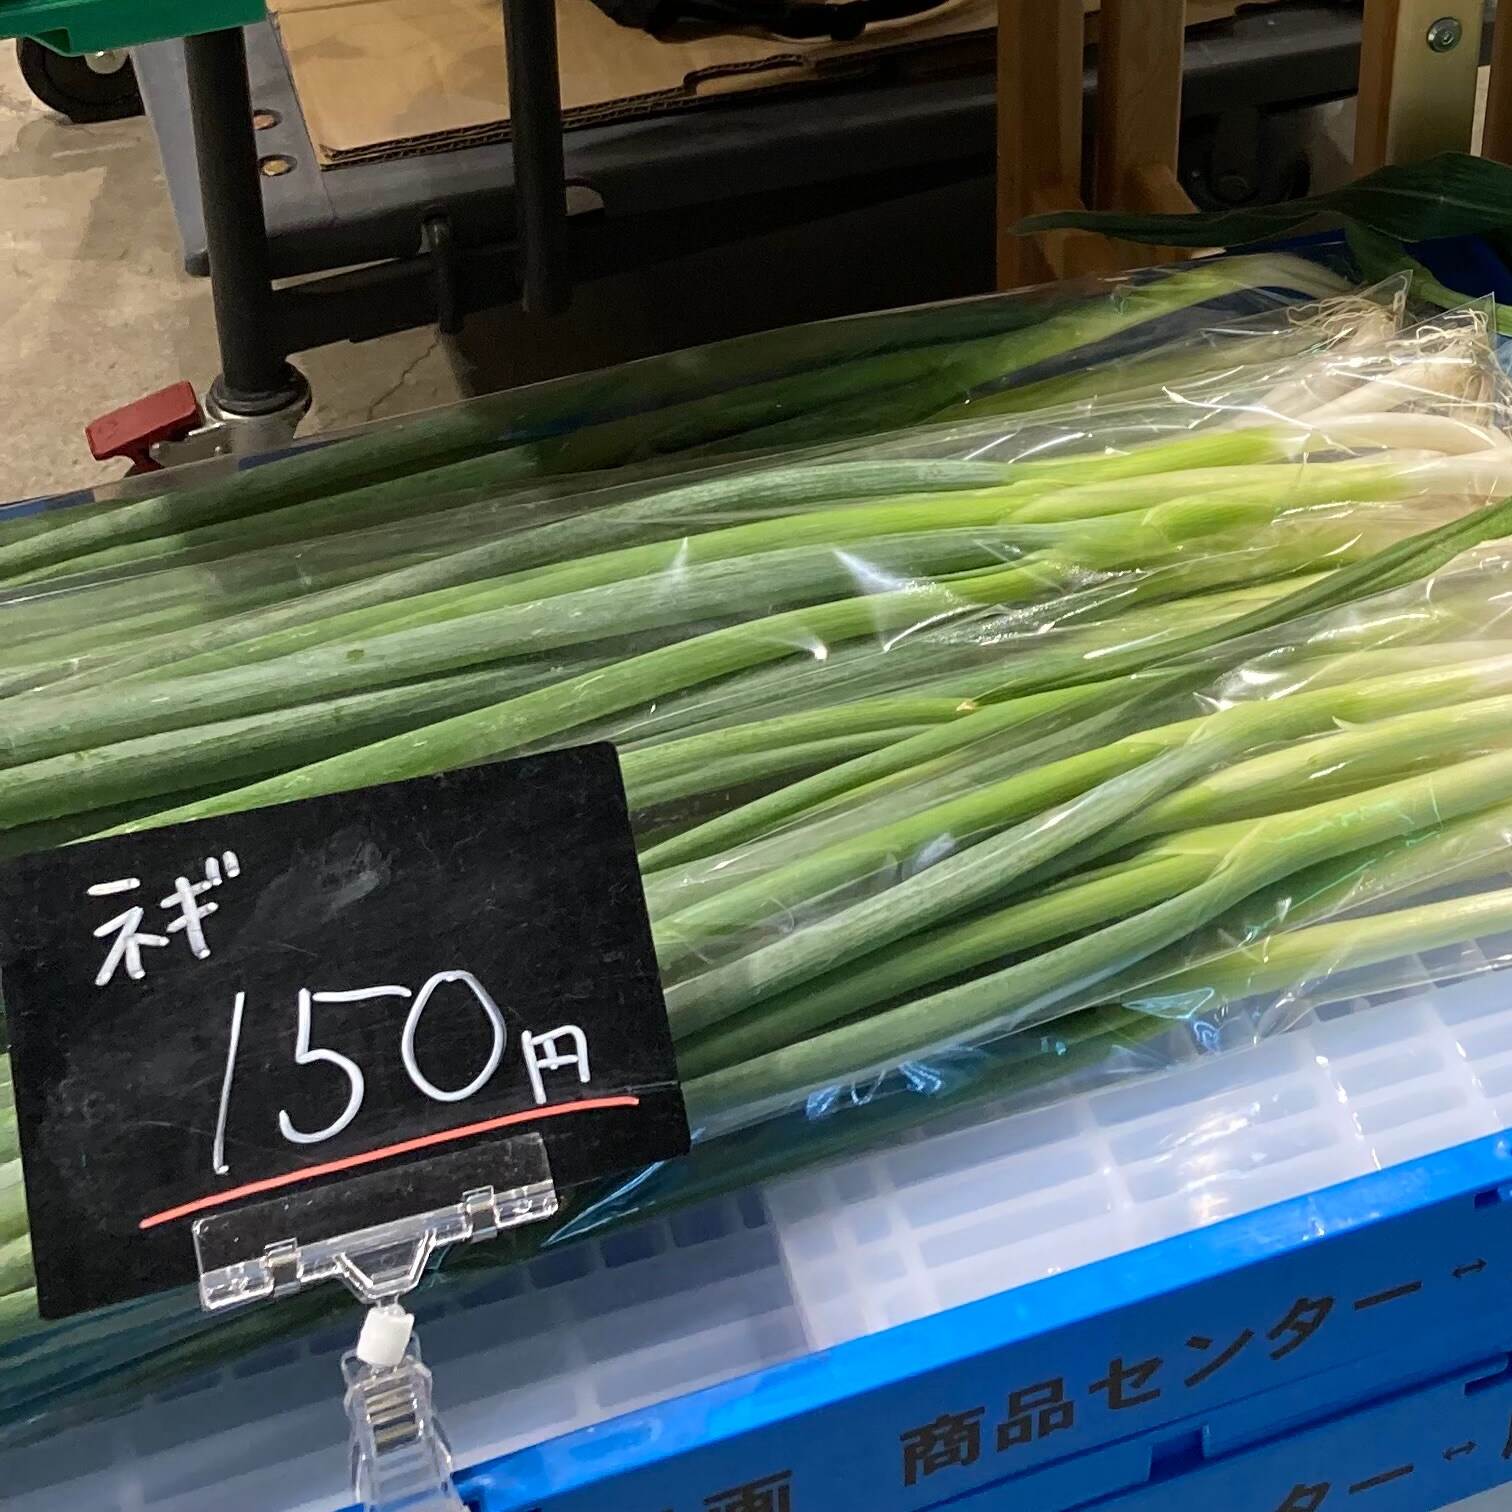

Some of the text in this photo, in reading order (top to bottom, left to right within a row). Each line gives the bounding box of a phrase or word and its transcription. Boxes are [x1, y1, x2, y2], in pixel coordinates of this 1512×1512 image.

[87, 850, 242, 986] ネギ
[214, 969, 591, 1175] 150円
[901, 1279, 1423, 1488] 商品センター
